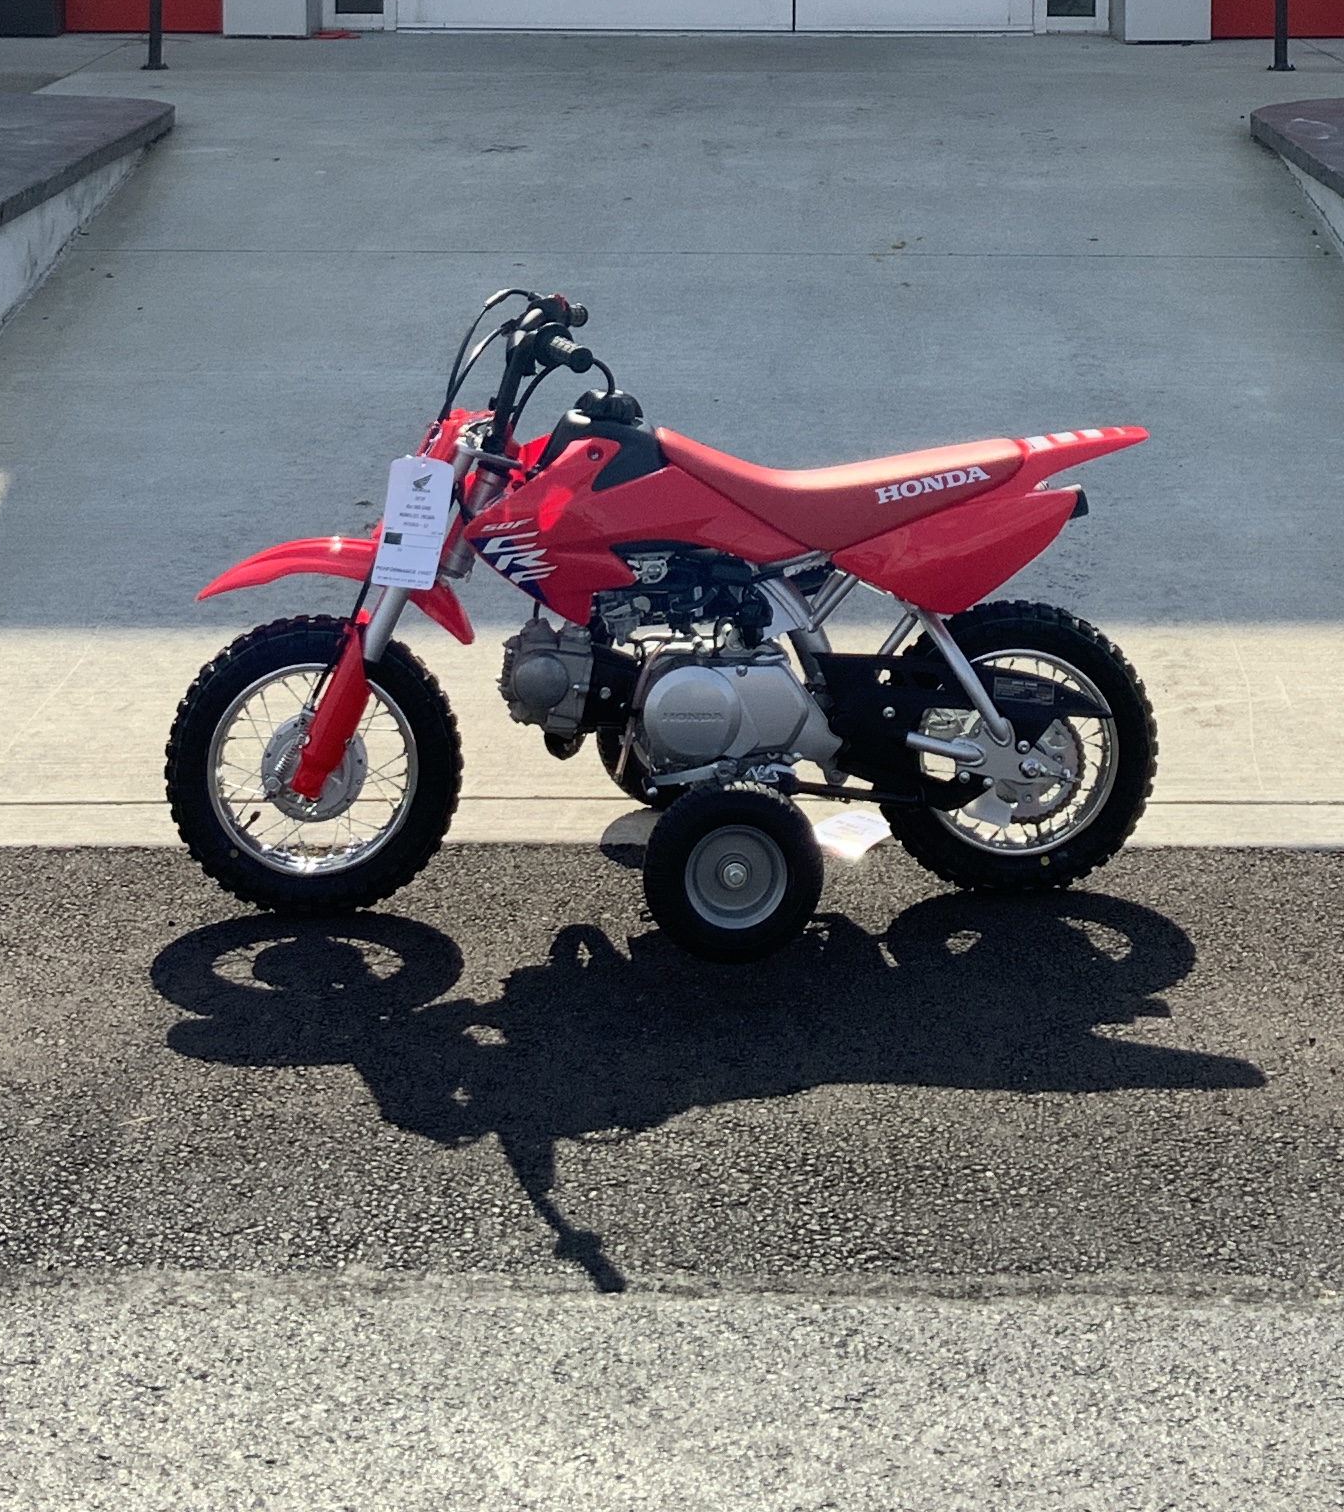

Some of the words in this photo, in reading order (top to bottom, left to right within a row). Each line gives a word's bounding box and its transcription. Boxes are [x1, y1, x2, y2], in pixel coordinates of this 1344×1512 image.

[873, 465, 991, 506] HONDA
[480, 516, 535, 533] 50F
[482, 530, 559, 585] CRF
[661, 711, 726, 723] HONDA
